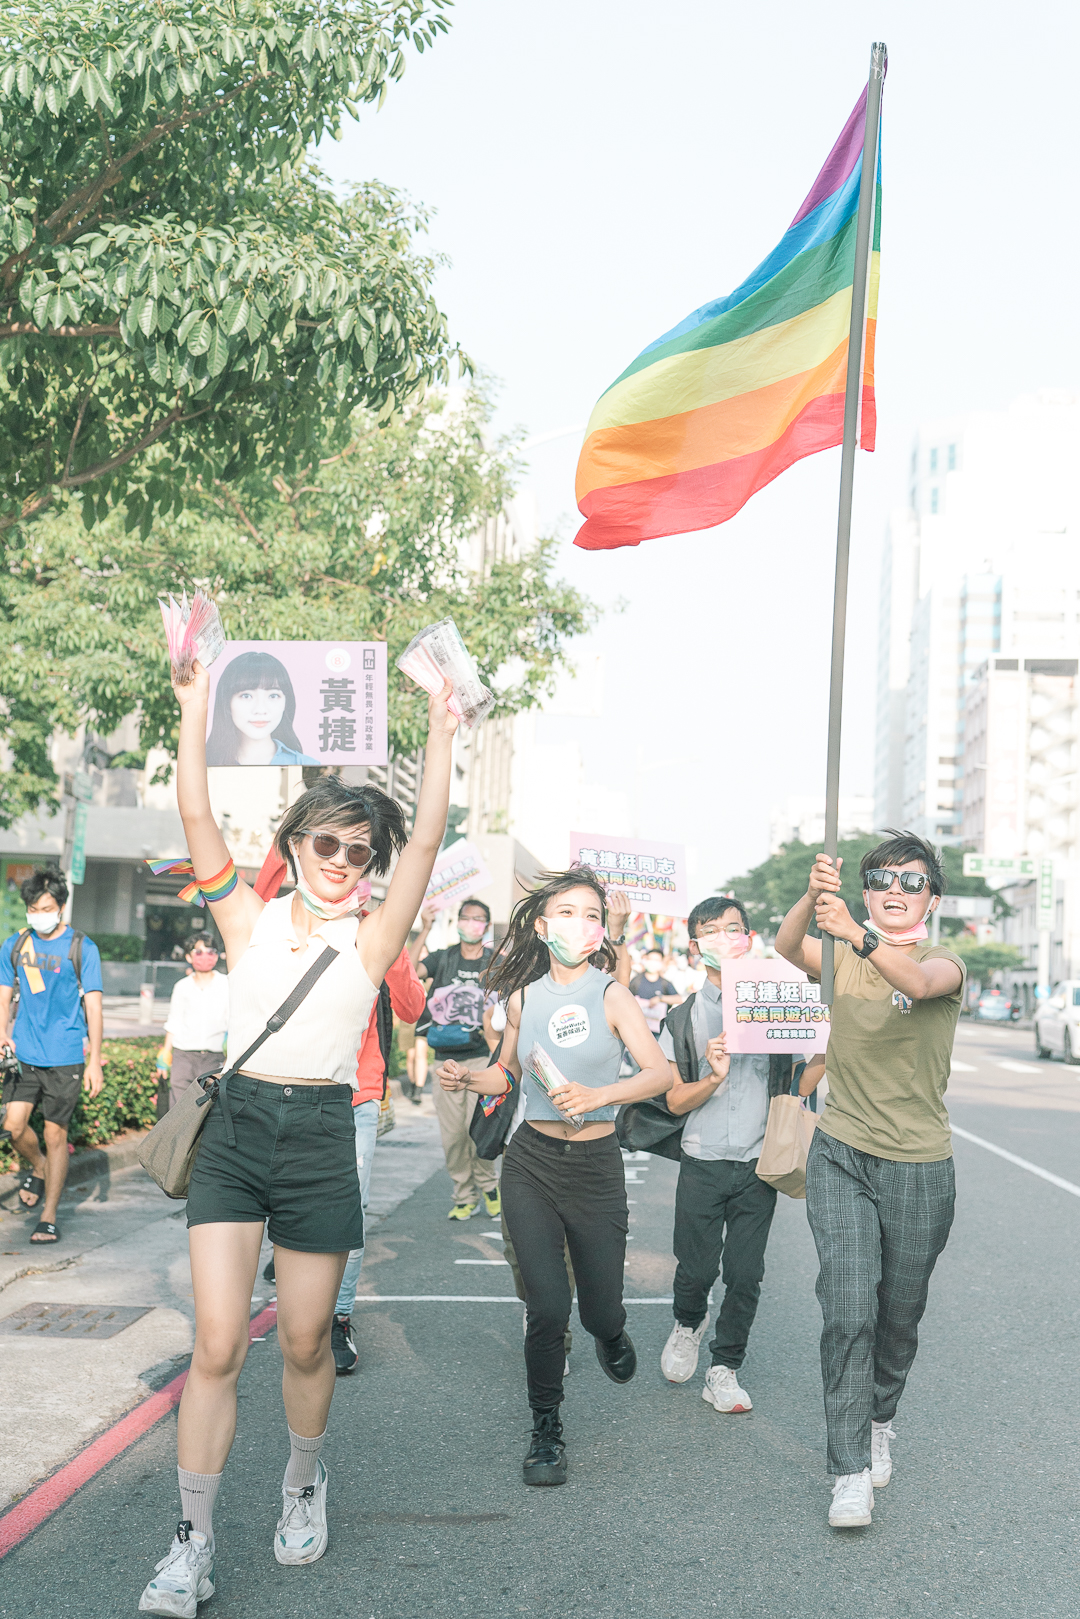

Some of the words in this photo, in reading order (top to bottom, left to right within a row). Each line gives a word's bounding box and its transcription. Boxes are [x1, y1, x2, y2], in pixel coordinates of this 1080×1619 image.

[334, 656, 342, 666] 8
[318, 677, 357, 753] 黃捷
[579, 848, 676, 875] 黃捷挺同志
[595, 869, 676, 892] 雄同遊13th
[735, 980, 822, 1004] 黃捷挺同
[735, 1005, 831, 1024] 高雄同遊13t
